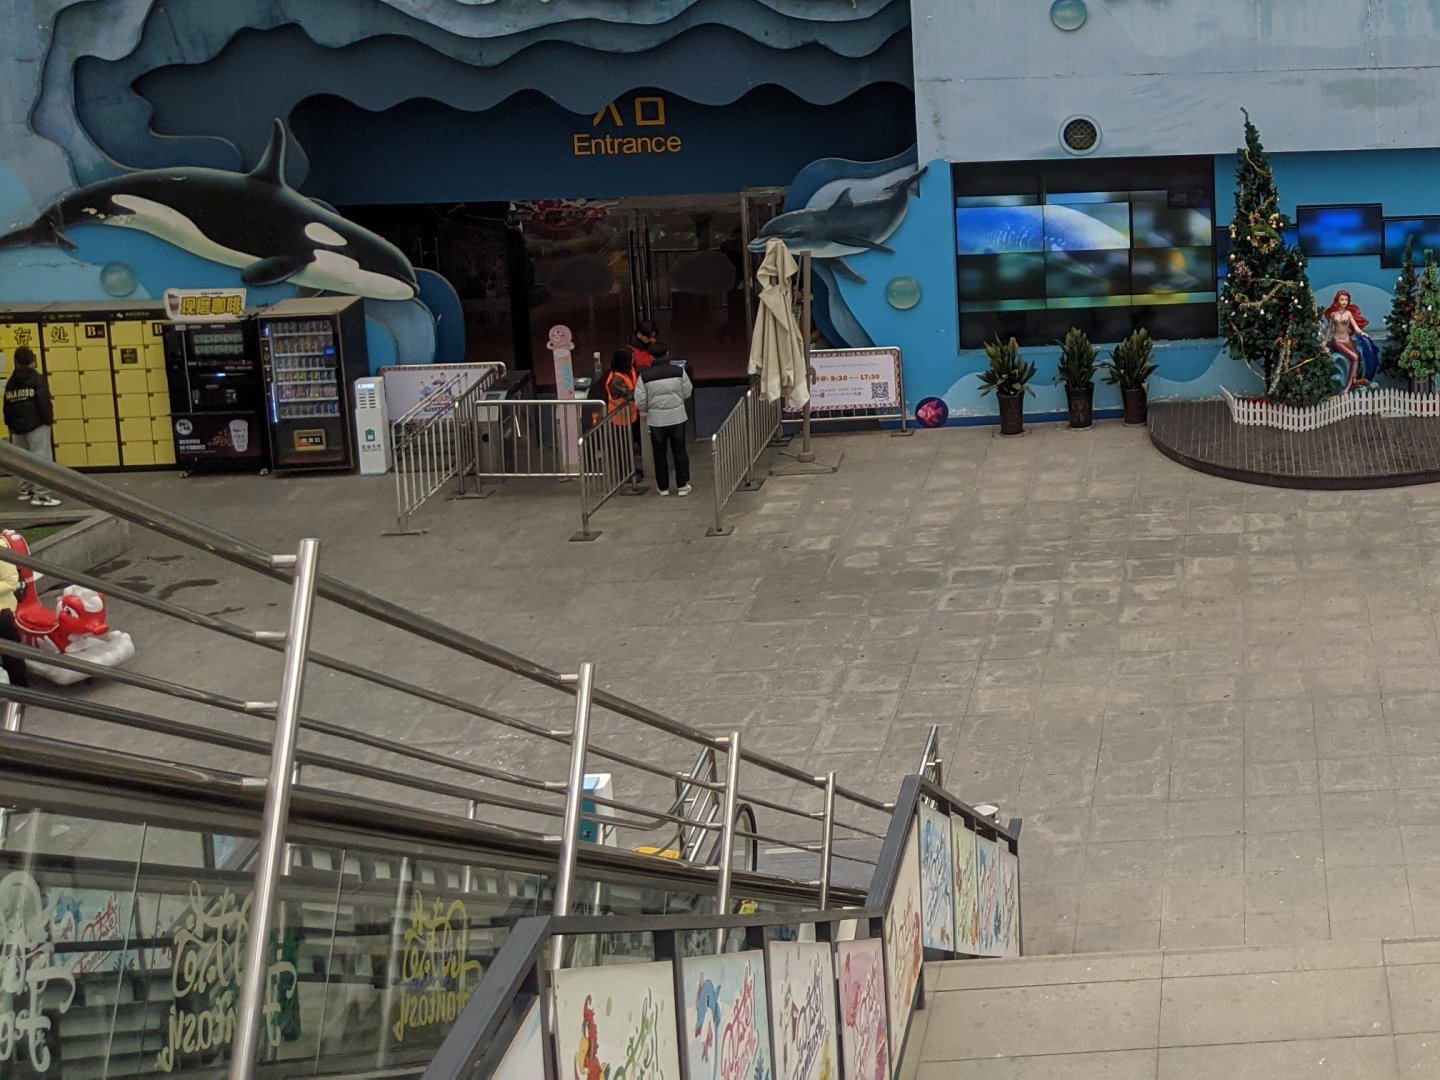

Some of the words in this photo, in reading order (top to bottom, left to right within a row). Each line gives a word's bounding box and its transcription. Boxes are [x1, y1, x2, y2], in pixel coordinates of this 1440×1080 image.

[573, 134, 682, 156] Entrance
[180, 296, 242, 316] 现磨咖啡
